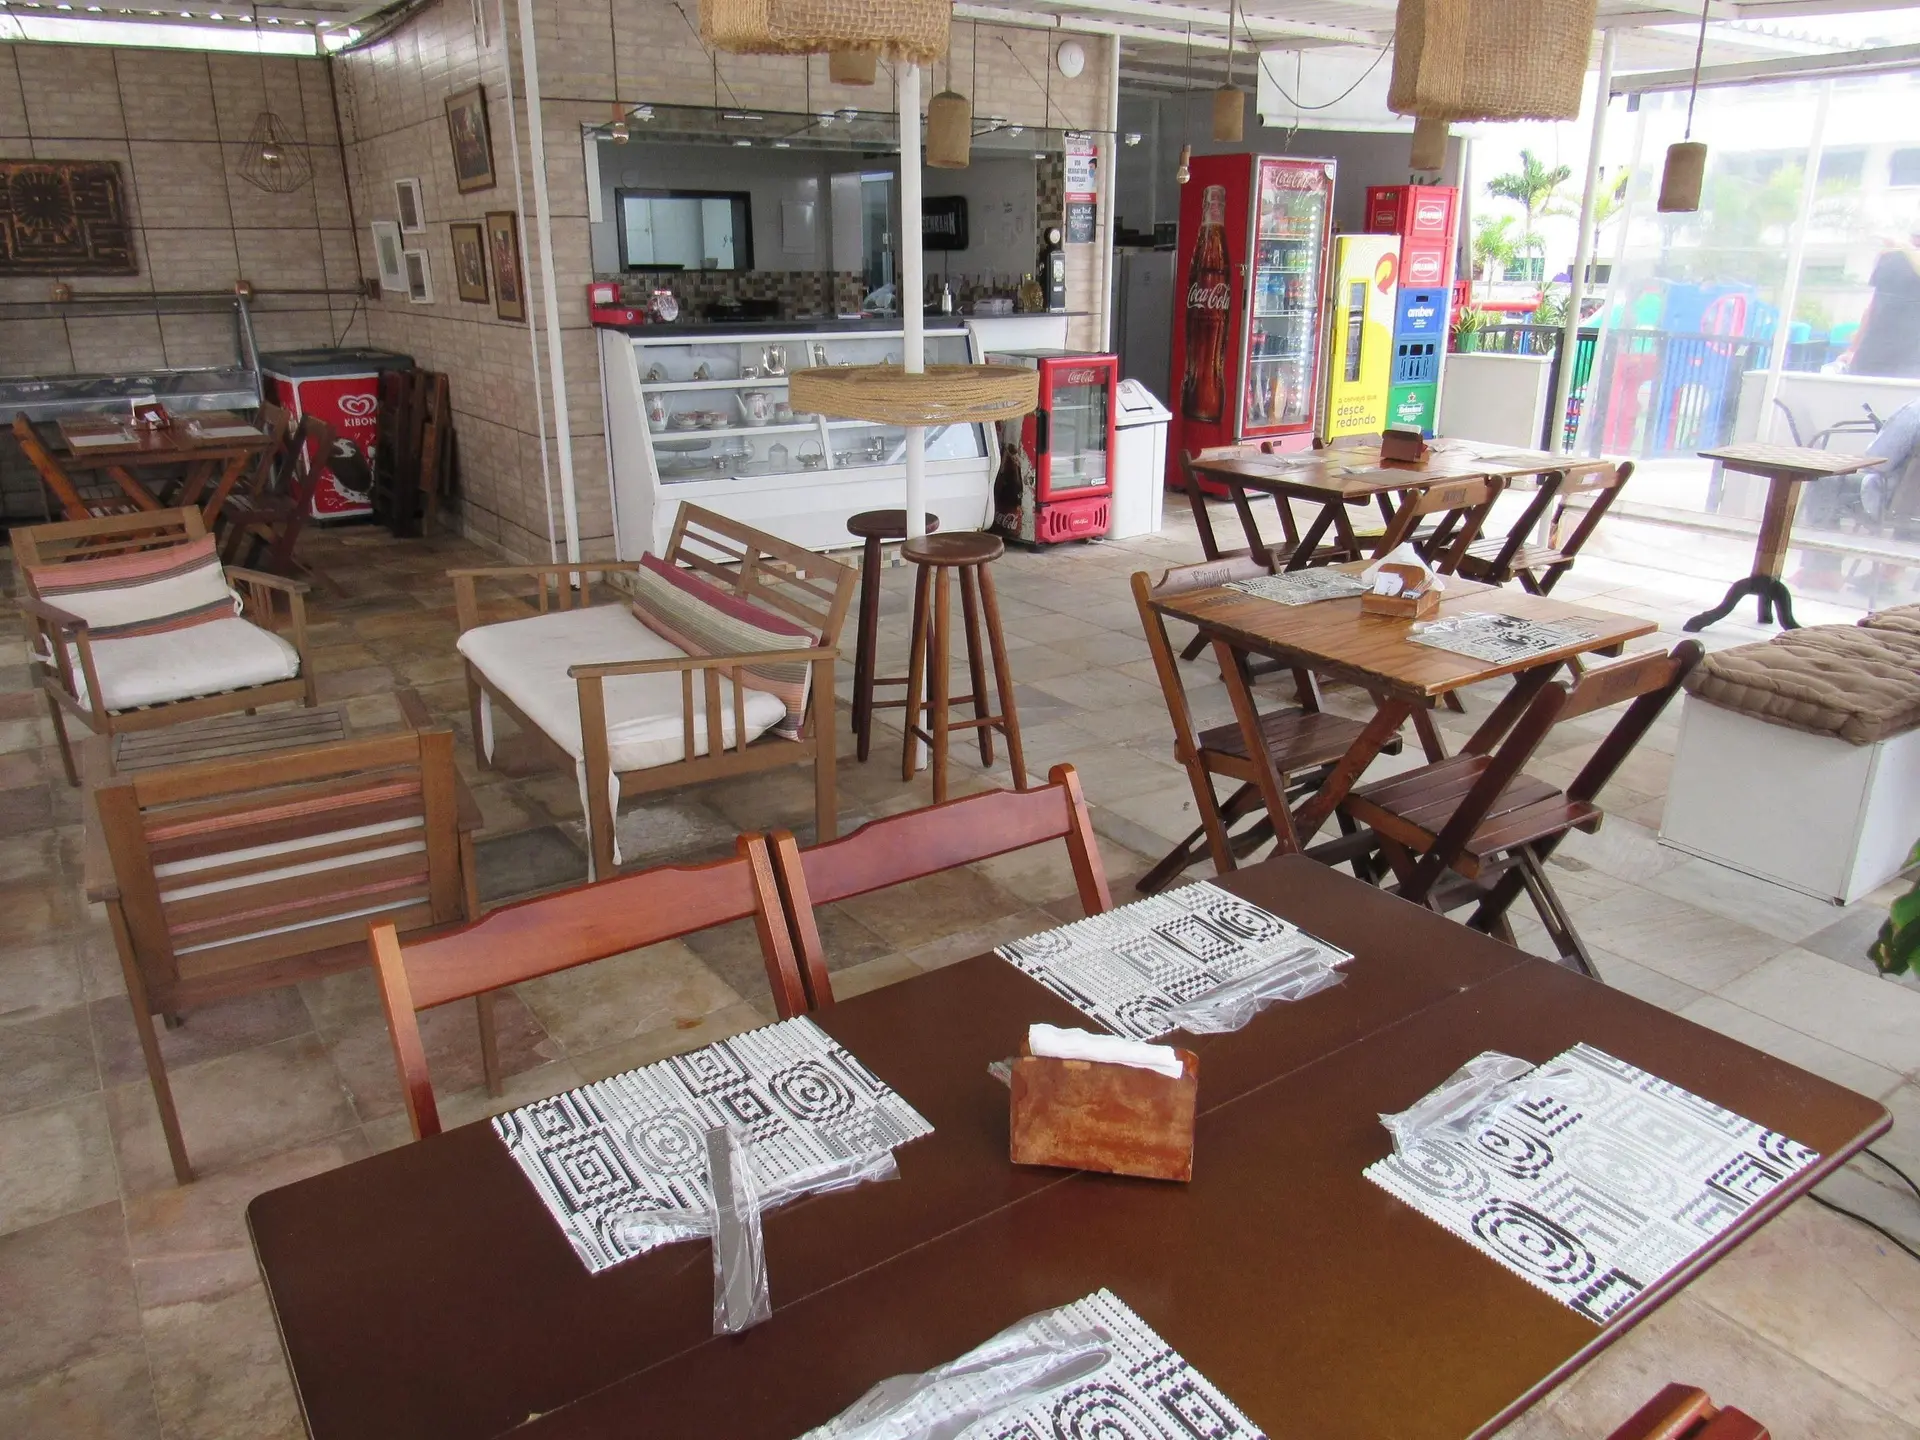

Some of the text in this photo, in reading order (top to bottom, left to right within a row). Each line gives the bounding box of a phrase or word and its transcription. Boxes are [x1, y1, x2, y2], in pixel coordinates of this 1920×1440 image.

[1187, 282, 1230, 310] Coca-Cola
[1407, 305, 1434, 318] ambev
[1337, 404, 1365, 416] desce
[344, 417, 377, 427] KIBON
[1336, 413, 1376, 428] redondo
